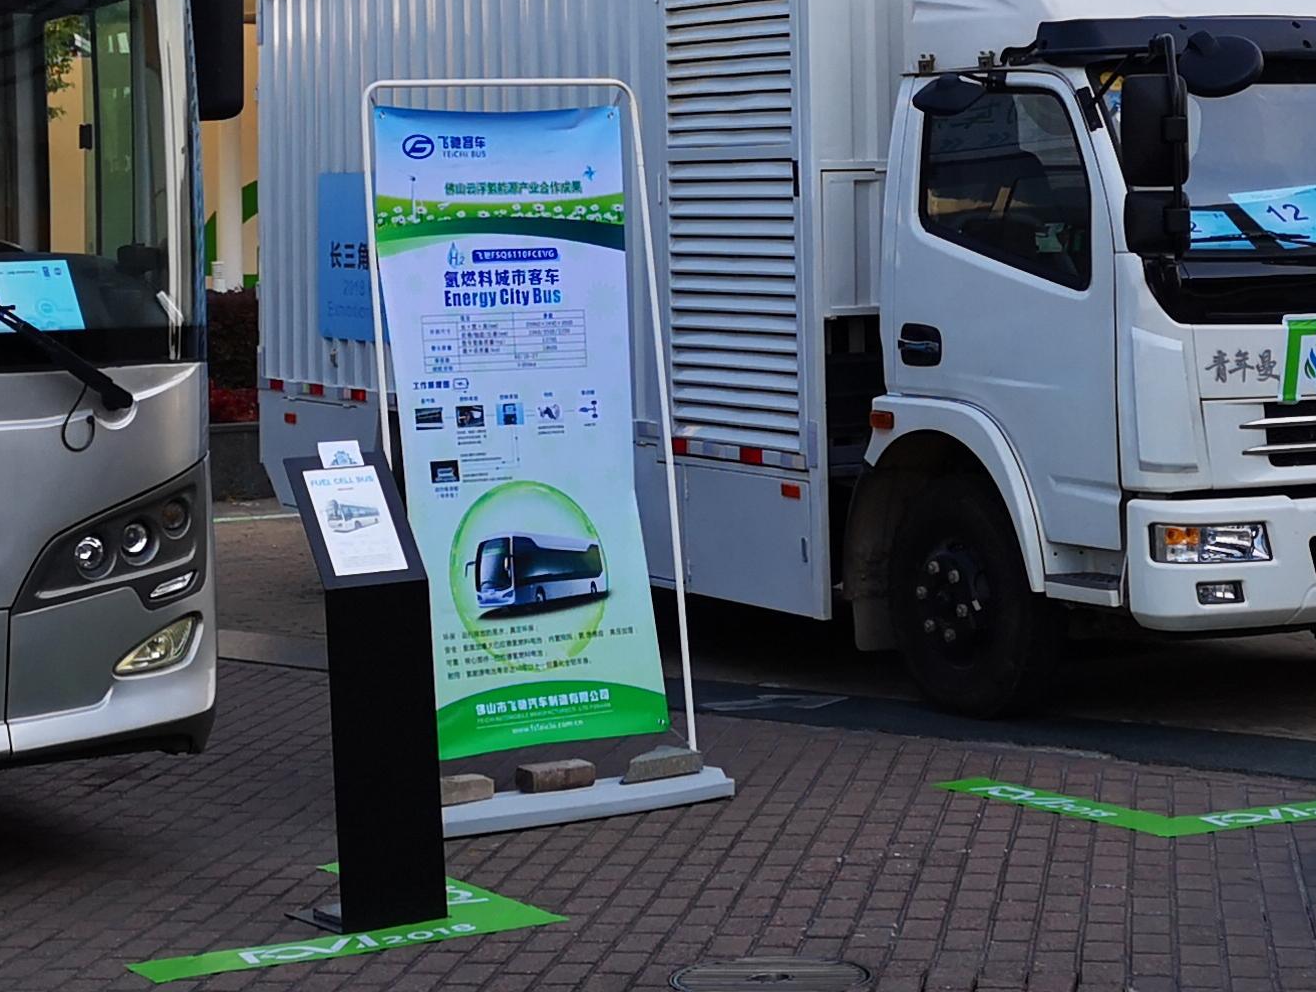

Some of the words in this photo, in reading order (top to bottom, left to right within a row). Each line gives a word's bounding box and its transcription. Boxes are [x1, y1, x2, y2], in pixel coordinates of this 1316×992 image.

[1266, 203, 1309, 223] 12
[444, 291, 497, 308] Energy
[499, 288, 530, 306] City
[533, 287, 562, 304] Bus
